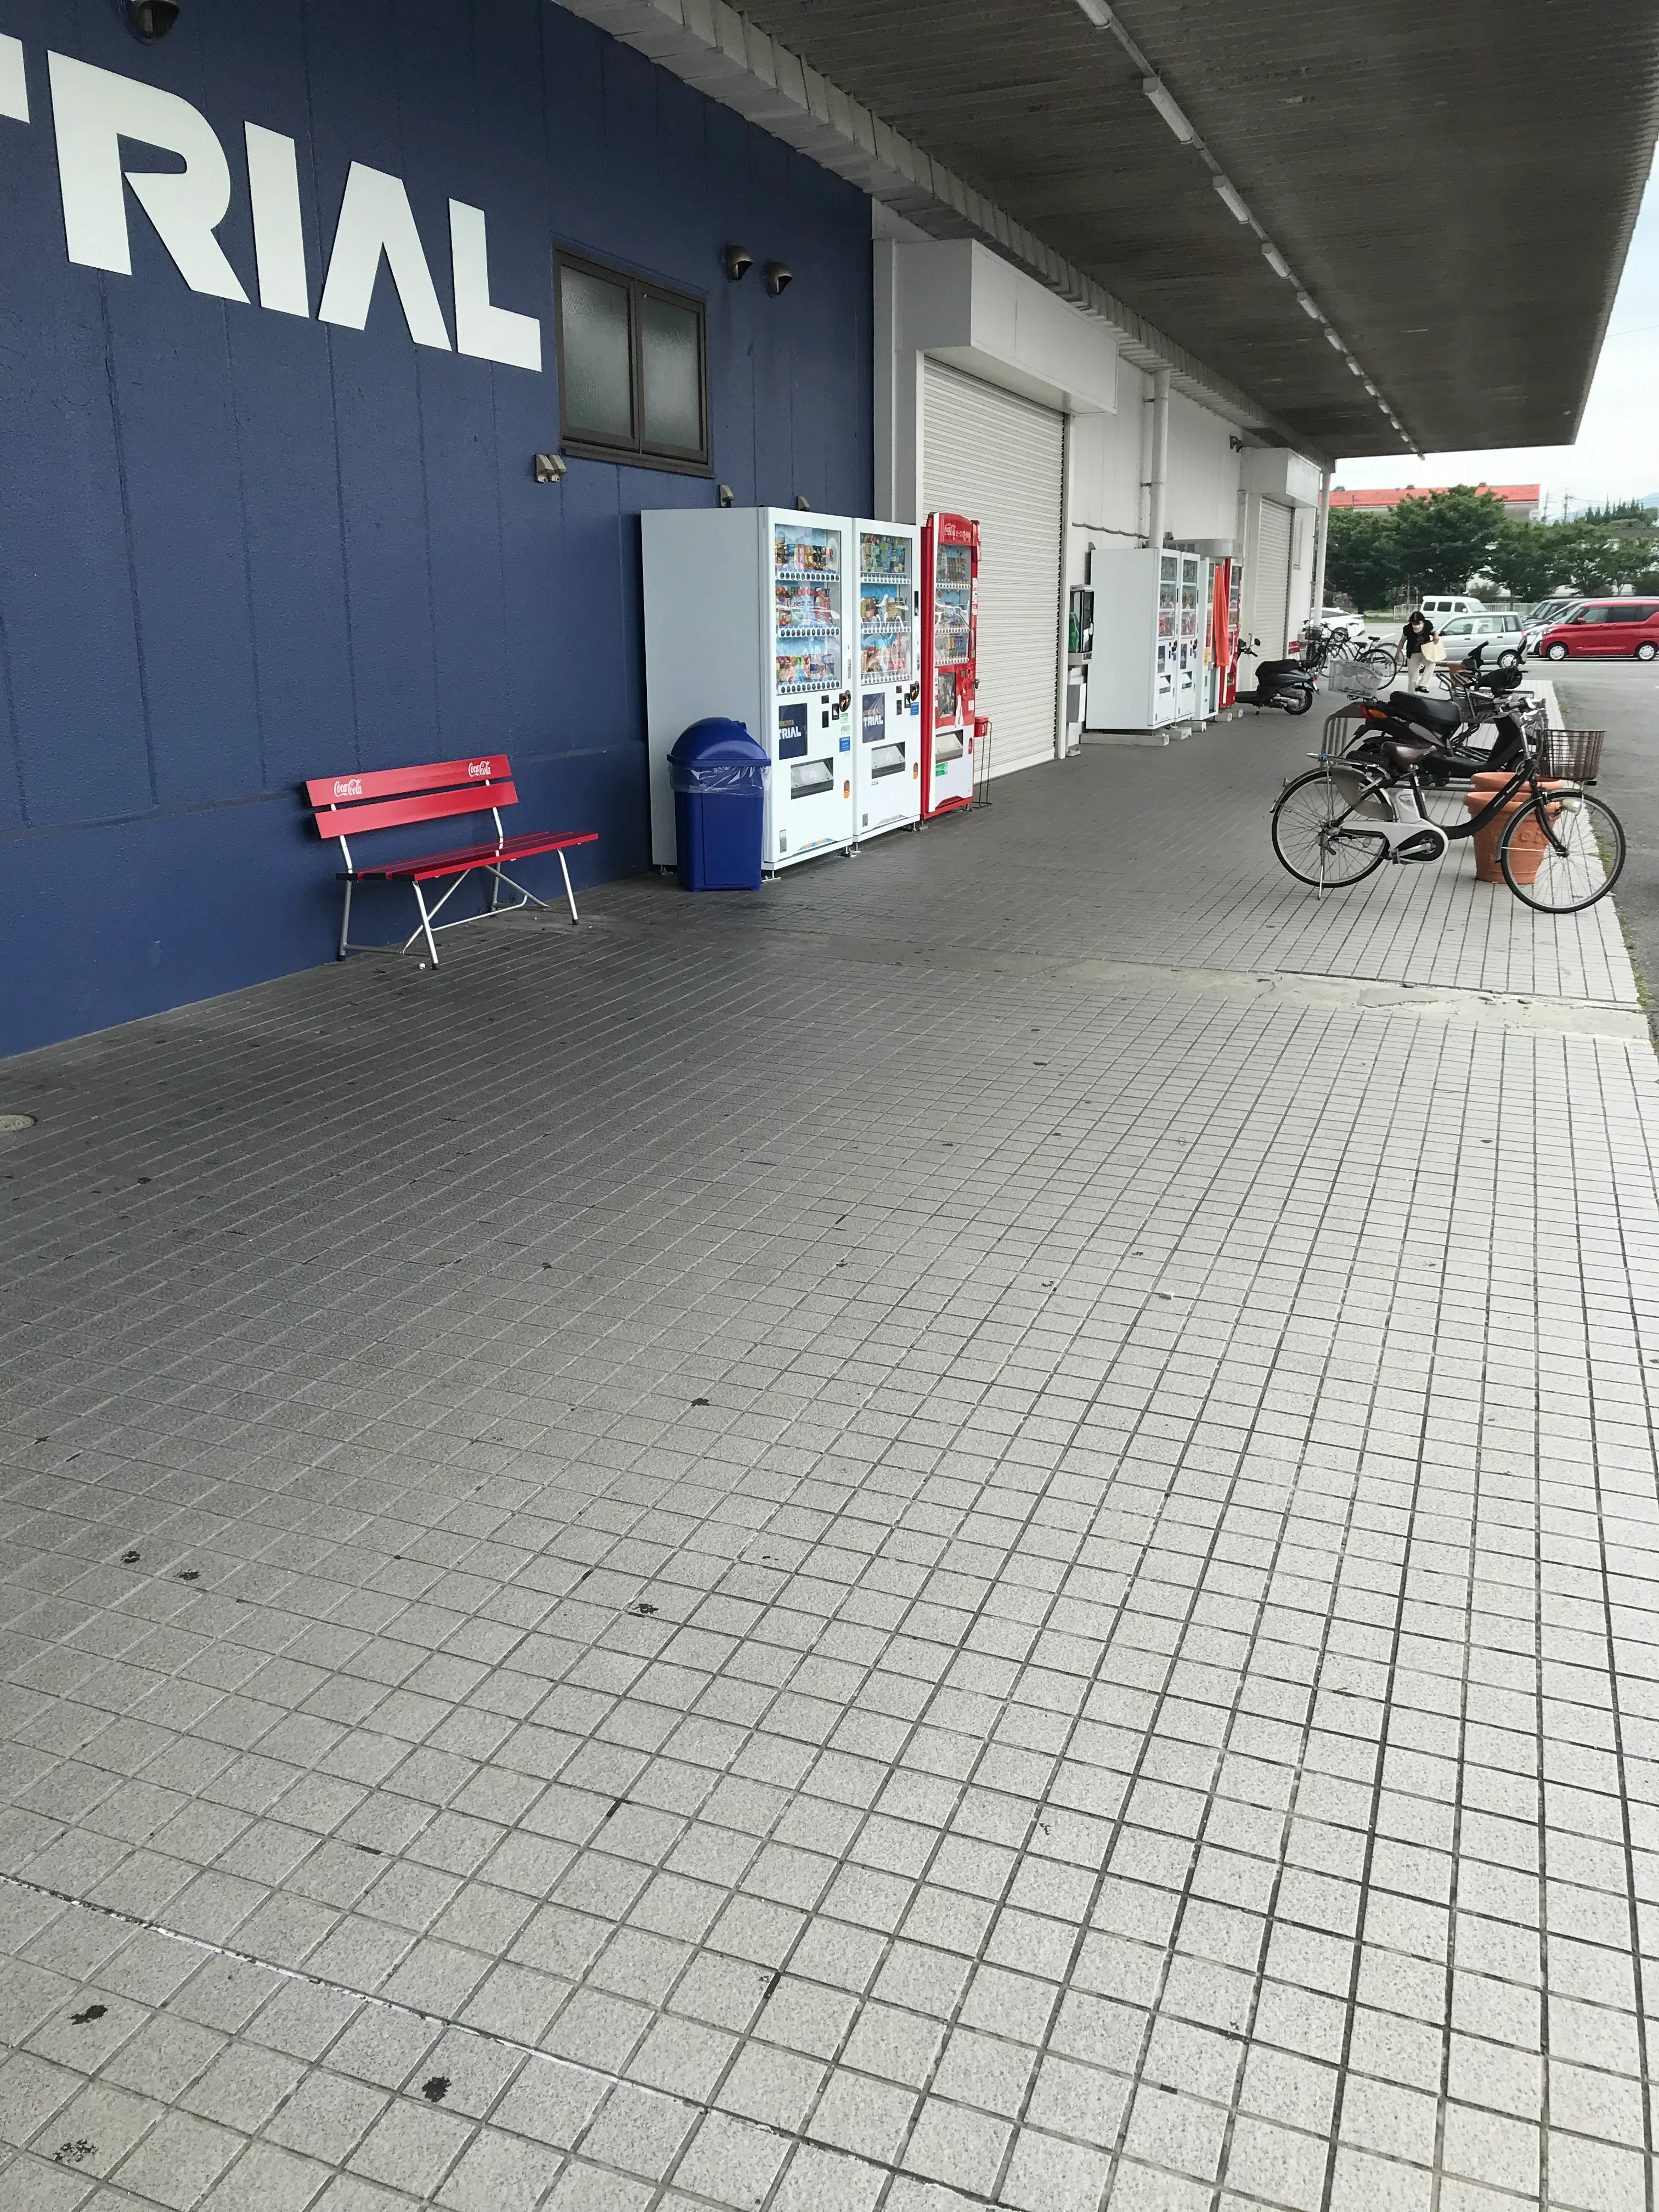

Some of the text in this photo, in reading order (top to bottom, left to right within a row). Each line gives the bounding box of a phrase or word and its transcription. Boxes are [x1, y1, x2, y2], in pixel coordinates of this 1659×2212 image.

[863, 715, 883, 727] TRIAL
[779, 726, 802, 740] TRIAL
[468, 761, 491, 777] Coca-Cola
[334, 778, 362, 797] Coca-Cola
